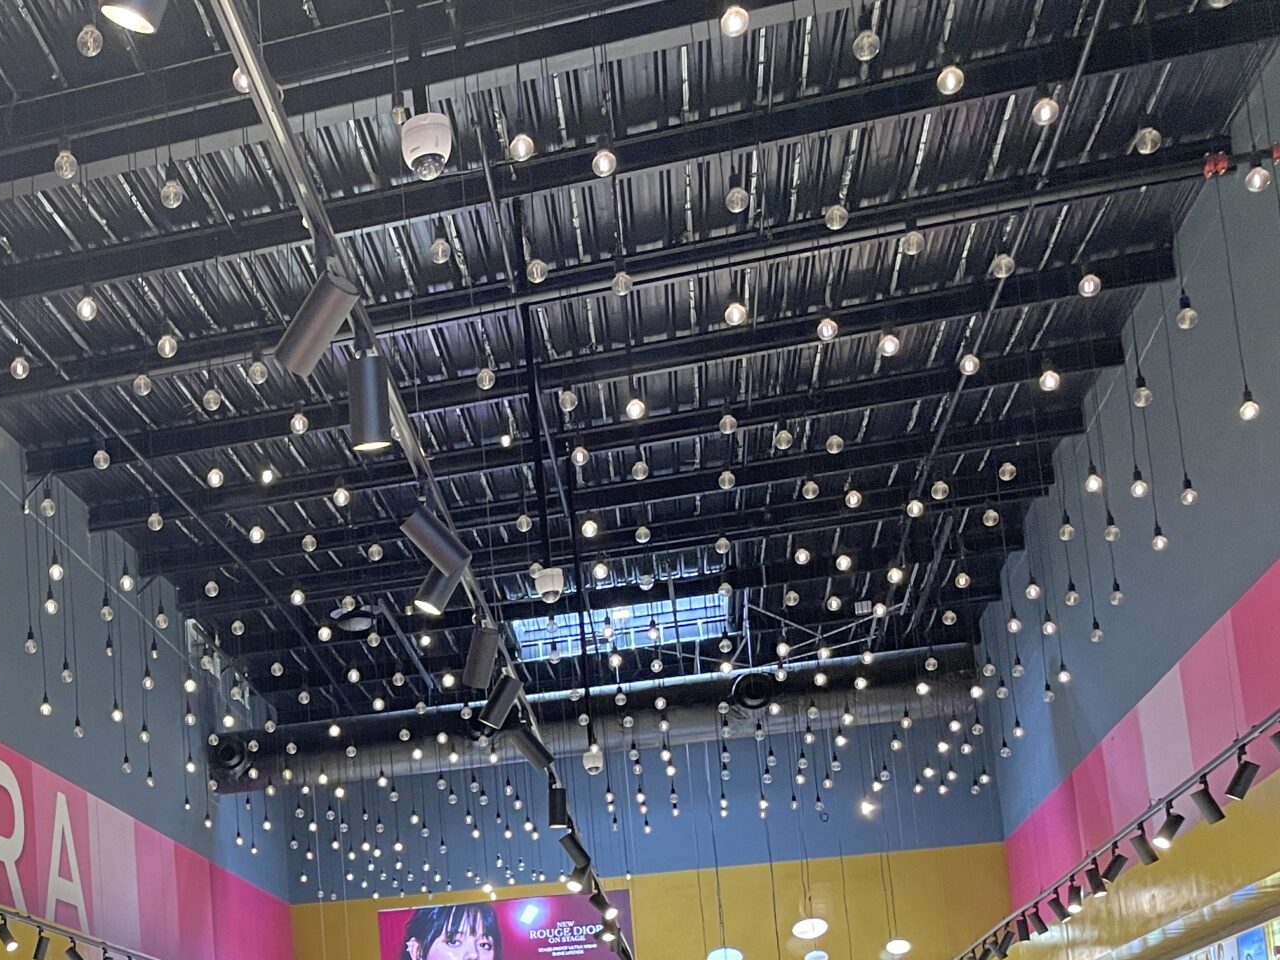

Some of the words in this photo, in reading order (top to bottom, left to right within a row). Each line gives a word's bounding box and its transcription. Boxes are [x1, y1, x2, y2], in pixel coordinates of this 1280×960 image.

[556, 920, 575, 928] NEW
[529, 927, 572, 939] ROUGE
[548, 936, 561, 944] ON
[561, 934, 586, 943] STAGE
